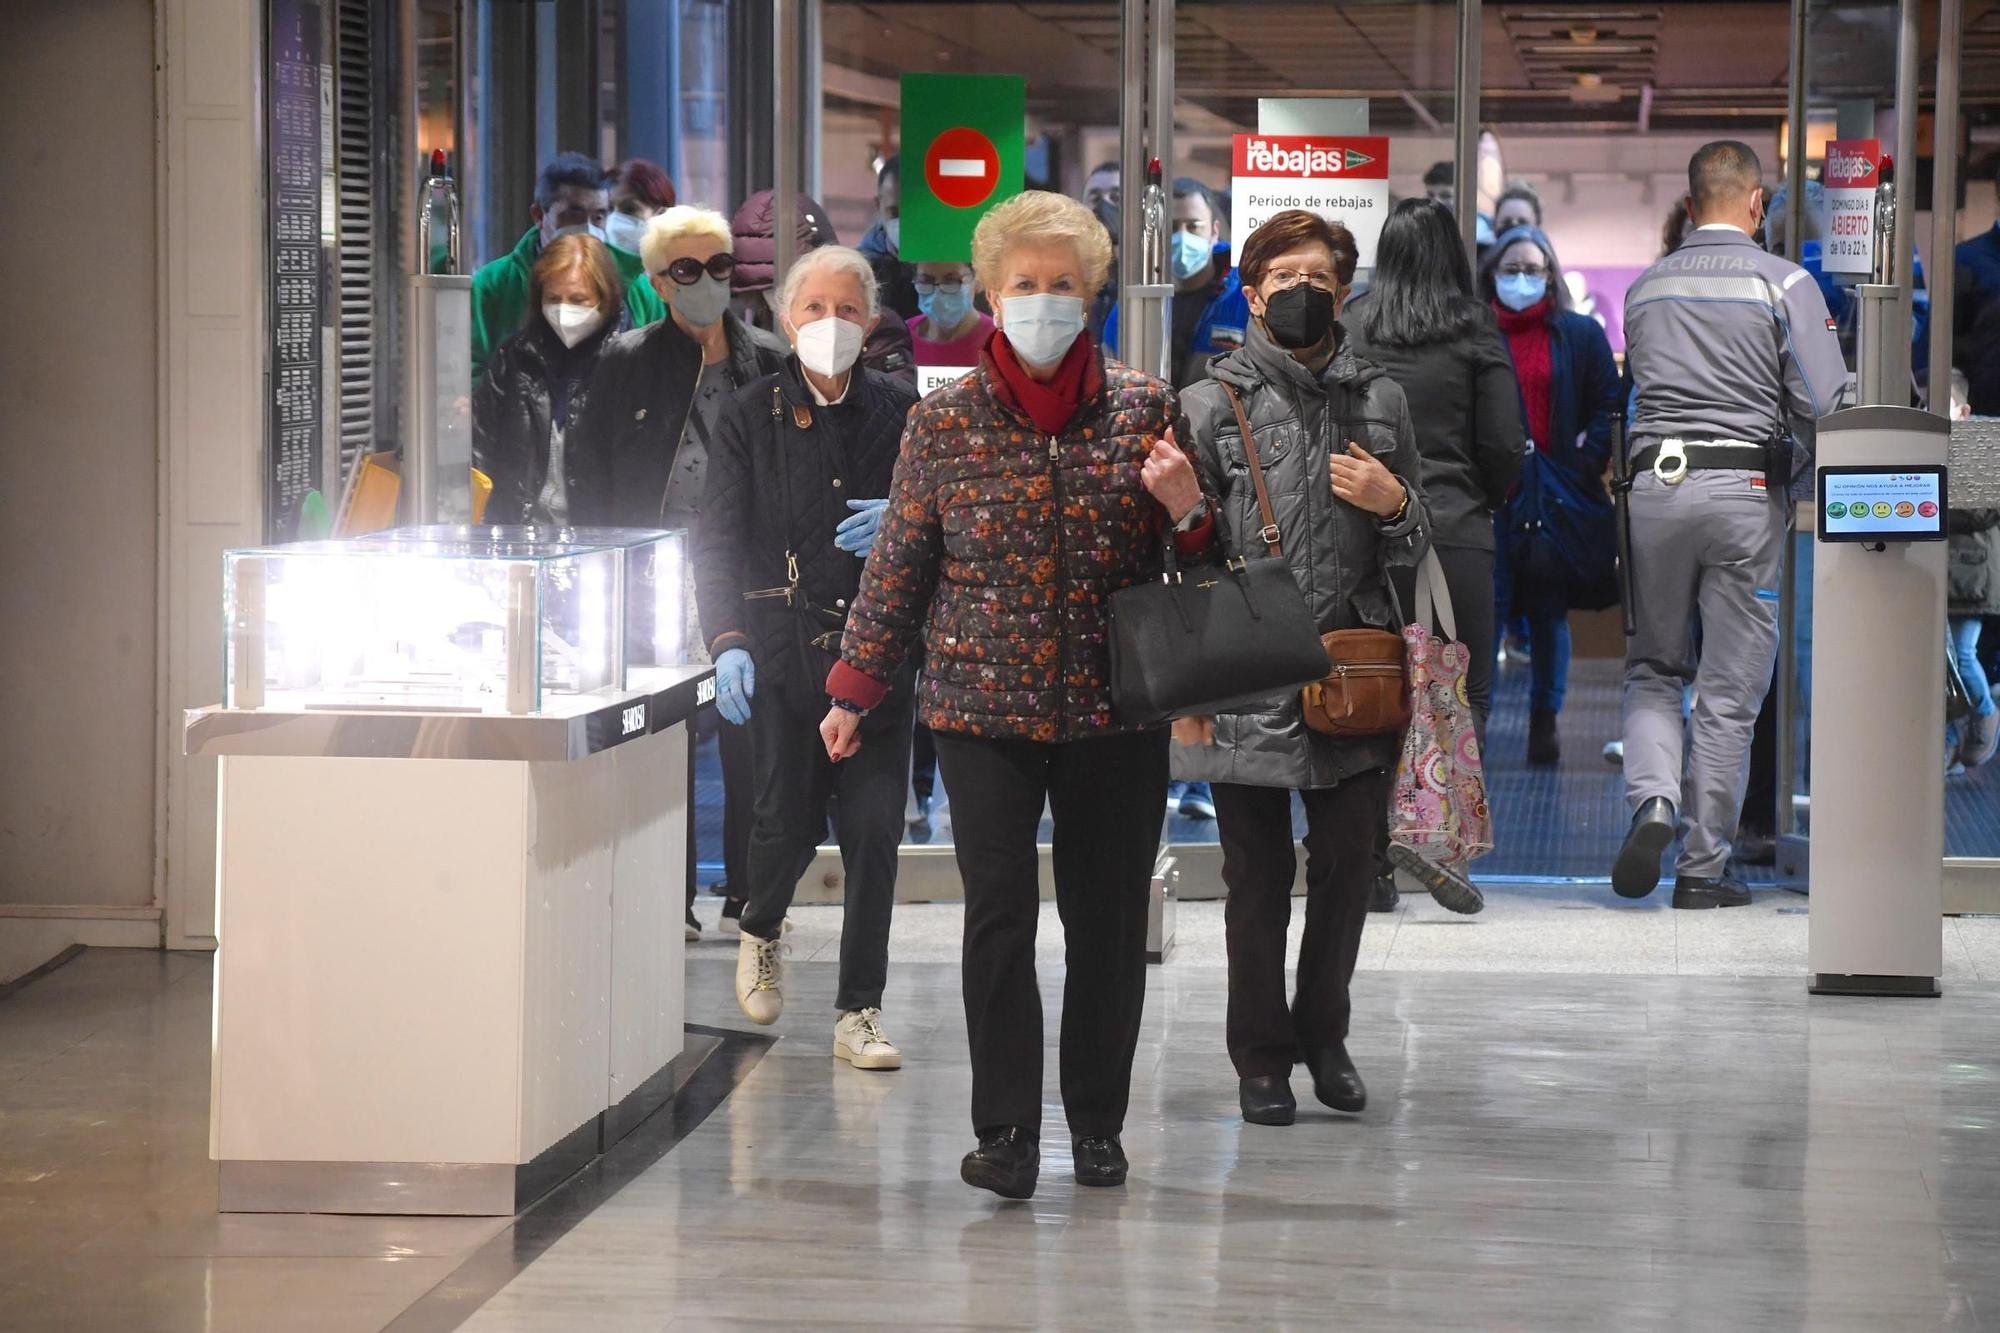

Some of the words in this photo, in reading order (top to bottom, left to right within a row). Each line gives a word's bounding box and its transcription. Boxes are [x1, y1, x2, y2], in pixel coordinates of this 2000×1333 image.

[1247, 138, 1267, 150] Las
[1247, 144, 1342, 177] rebajas
[1829, 151, 1864, 184] rebajas
[1249, 195, 1301, 208] Periodo
[1305, 196, 1322, 208] de
[1326, 196, 1373, 210] rebajas
[1832, 199, 1855, 210] DOMINGO
[1831, 215, 1869, 236] ABIERTO
[1830, 242, 1838, 255] de
[1840, 242, 1846, 255] 10
[1848, 245, 1852, 255] a
[1853, 241, 1861, 255] 22
[1651, 255, 1758, 272] ECURITAS
